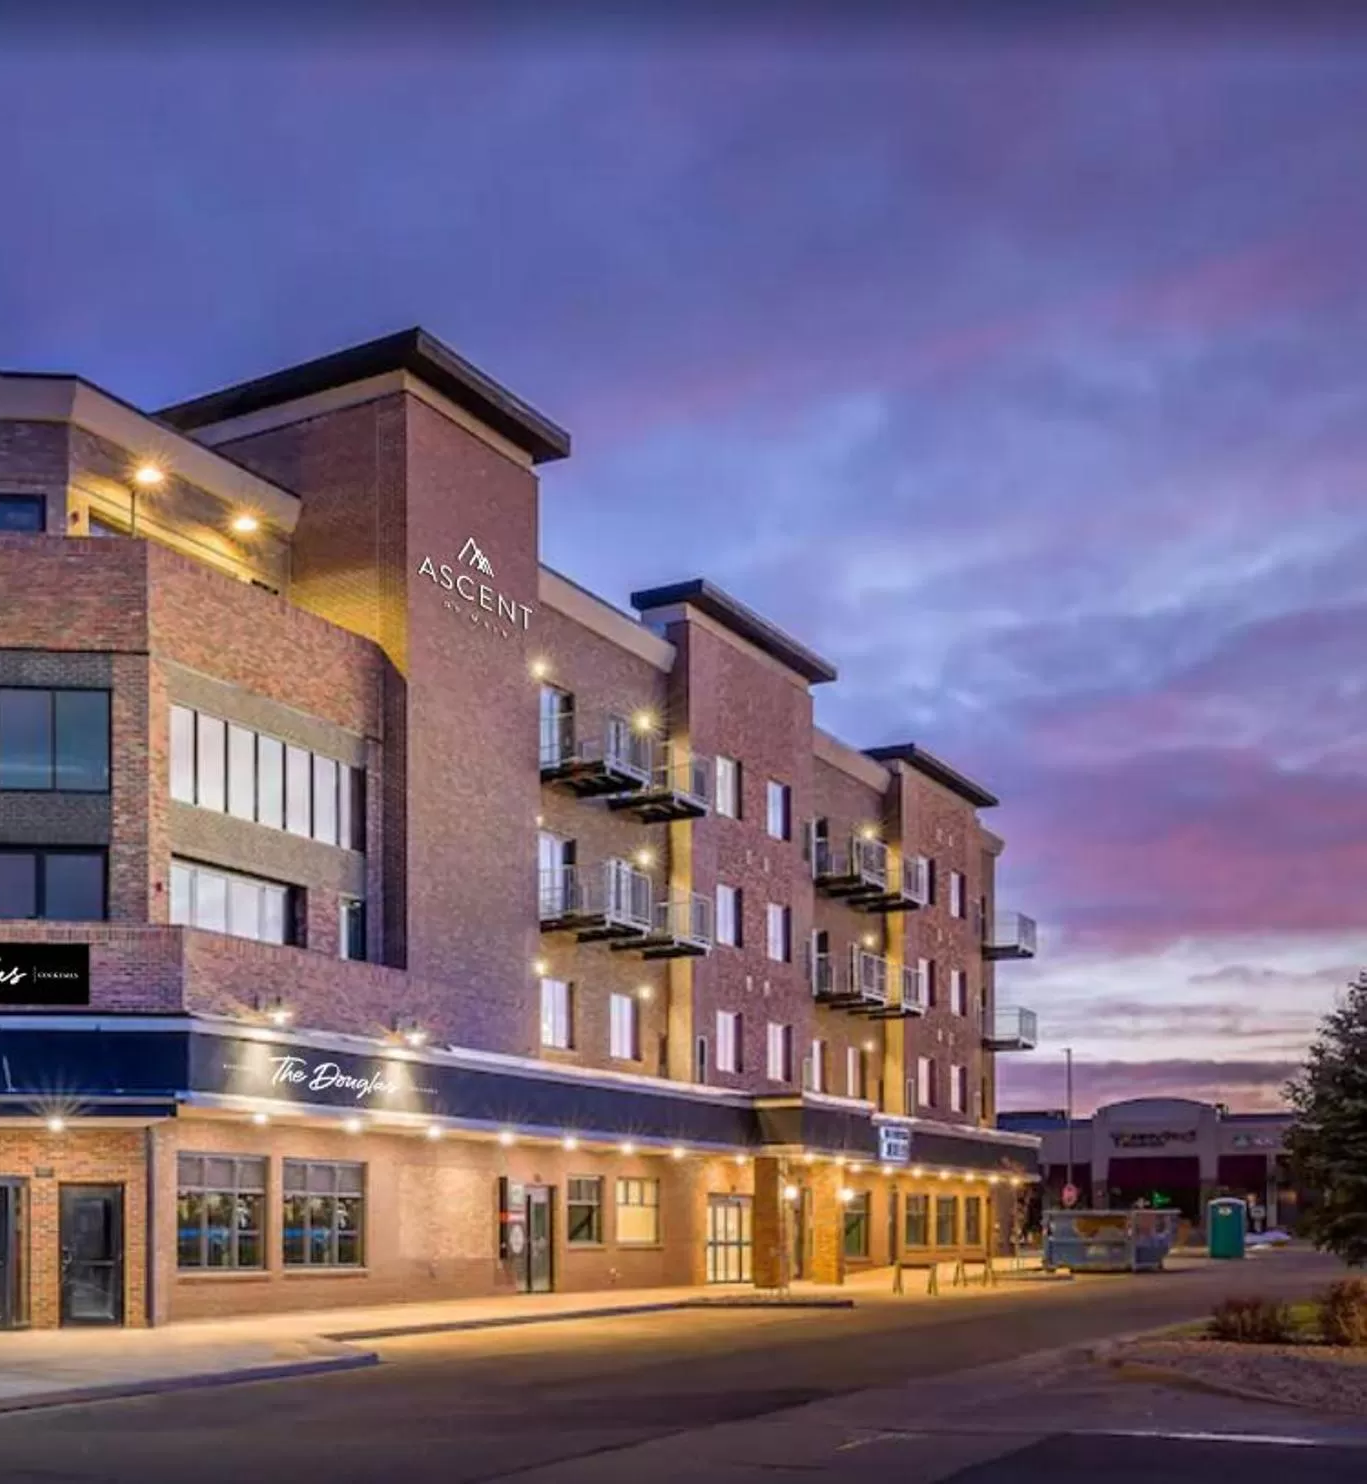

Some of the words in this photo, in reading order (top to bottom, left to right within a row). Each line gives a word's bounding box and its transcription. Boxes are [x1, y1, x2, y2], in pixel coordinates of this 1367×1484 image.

[418, 555, 533, 631] ASCENT
[268, 1055, 308, 1088] The
[308, 1062, 400, 1099] Douglas
